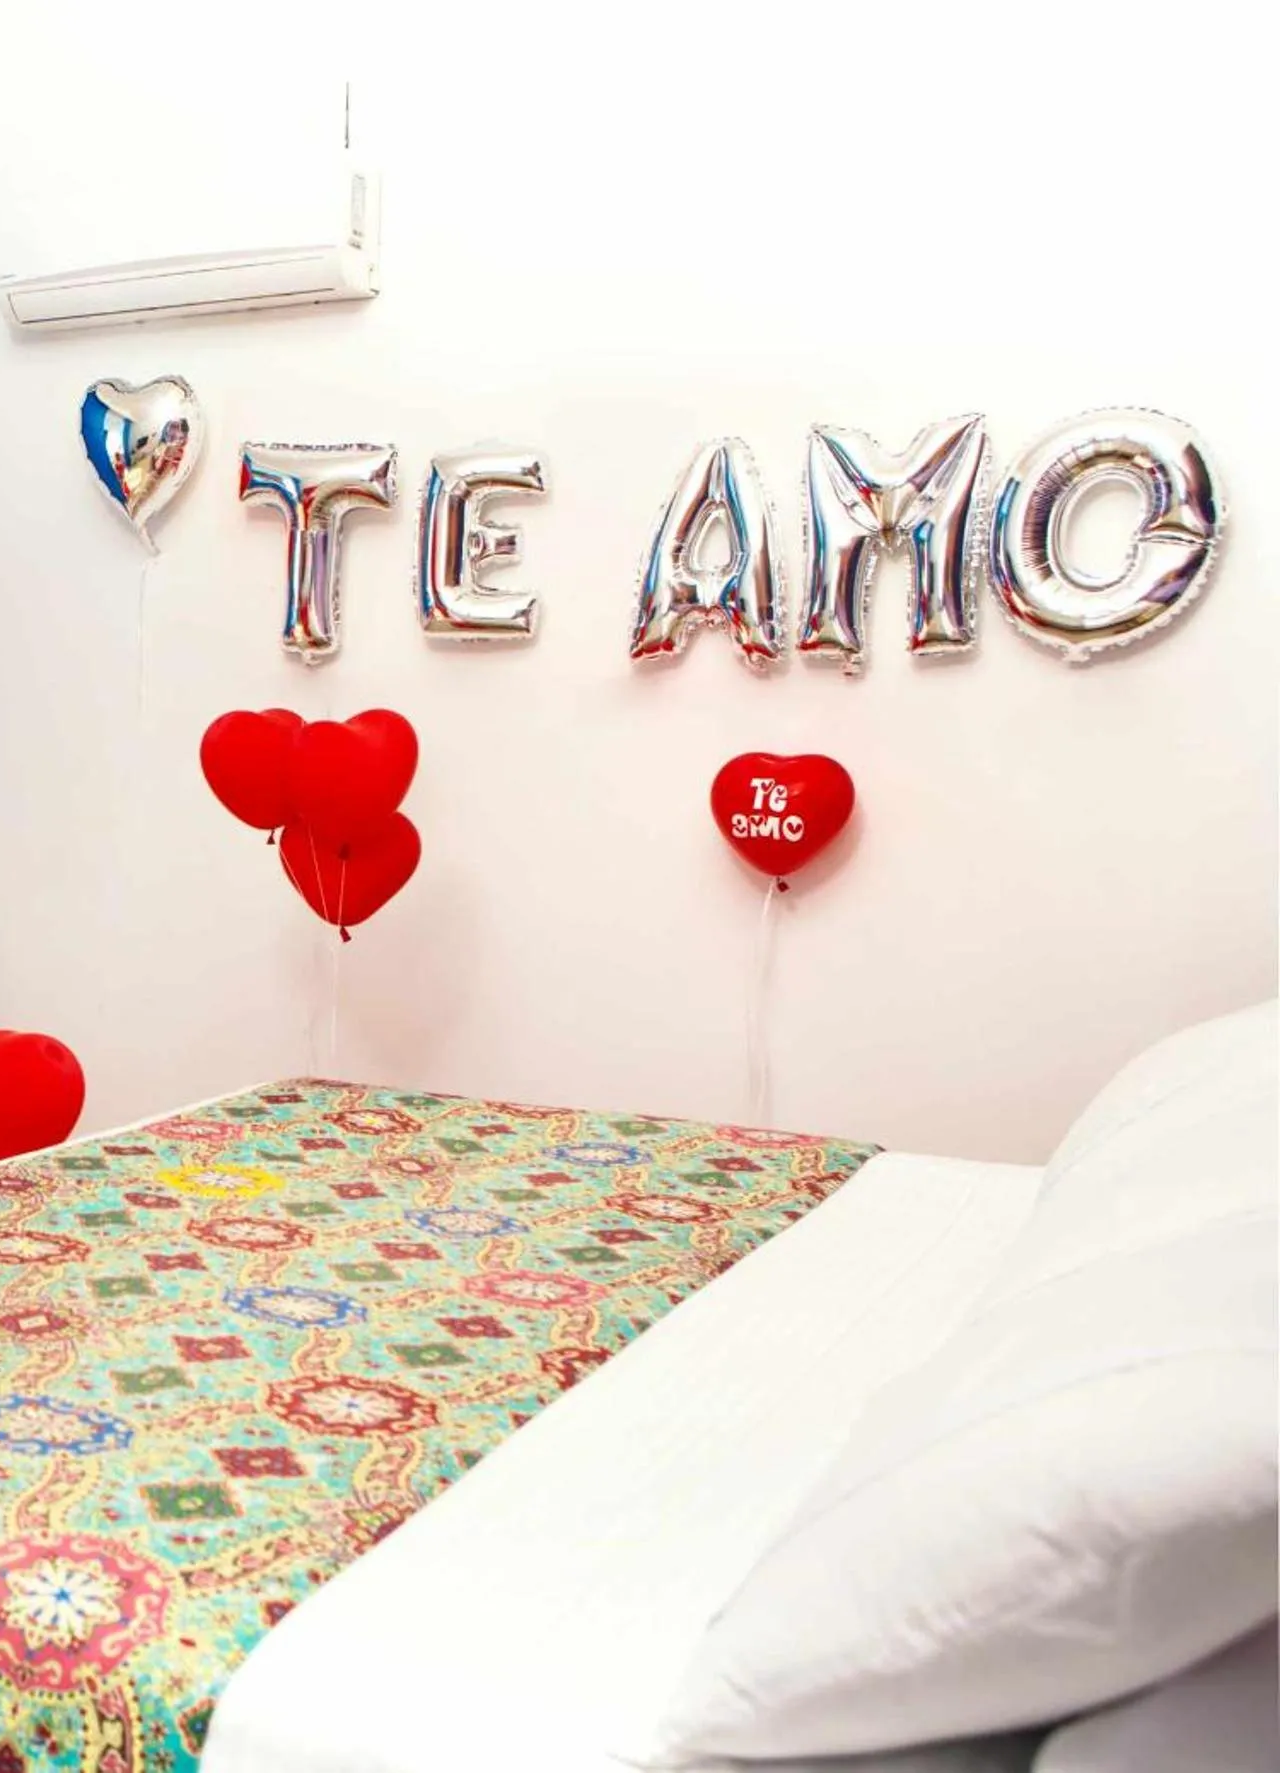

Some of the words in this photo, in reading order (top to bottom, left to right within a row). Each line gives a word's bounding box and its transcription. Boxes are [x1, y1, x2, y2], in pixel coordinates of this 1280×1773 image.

[239, 442, 552, 664] TE
[630, 405, 1228, 674] AMO
[750, 777, 788, 812] Te
